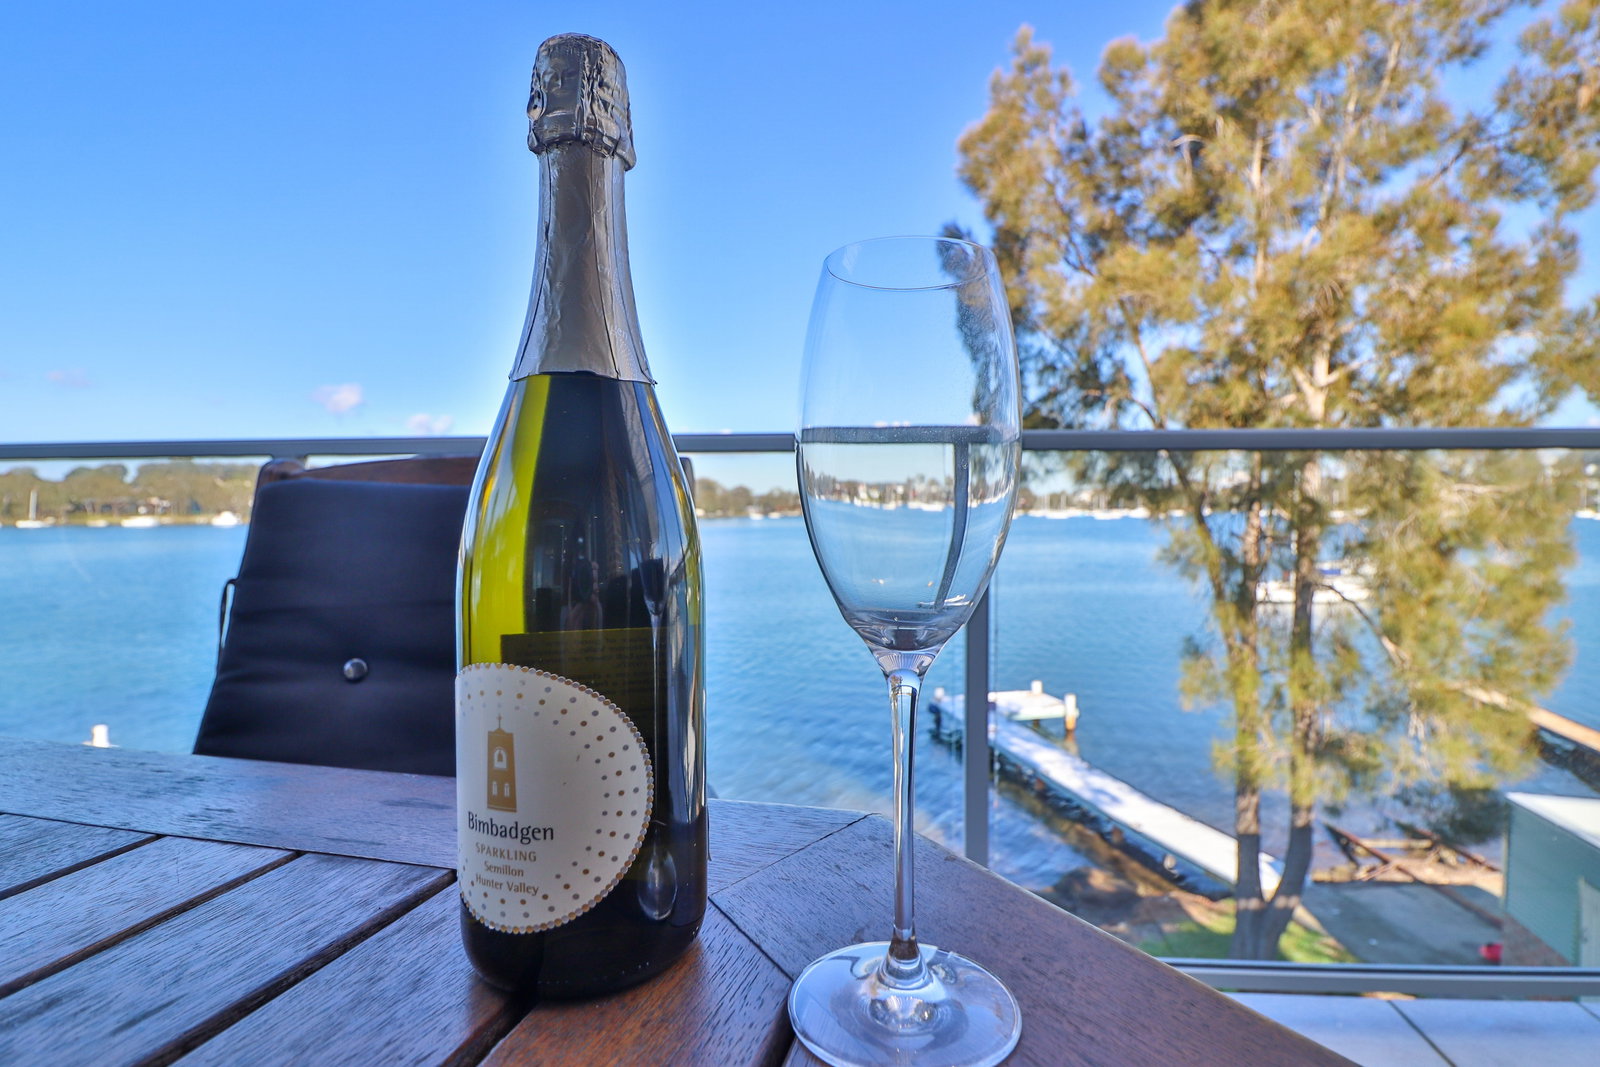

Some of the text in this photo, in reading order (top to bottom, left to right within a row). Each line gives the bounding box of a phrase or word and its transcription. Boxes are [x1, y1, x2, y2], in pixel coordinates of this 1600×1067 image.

[468, 811, 554, 845] Bimbadgen
[475, 842, 537, 862] SPARKLING
[484, 861, 524, 877] Semillon
[475, 873, 539, 896] Hunter Valley
